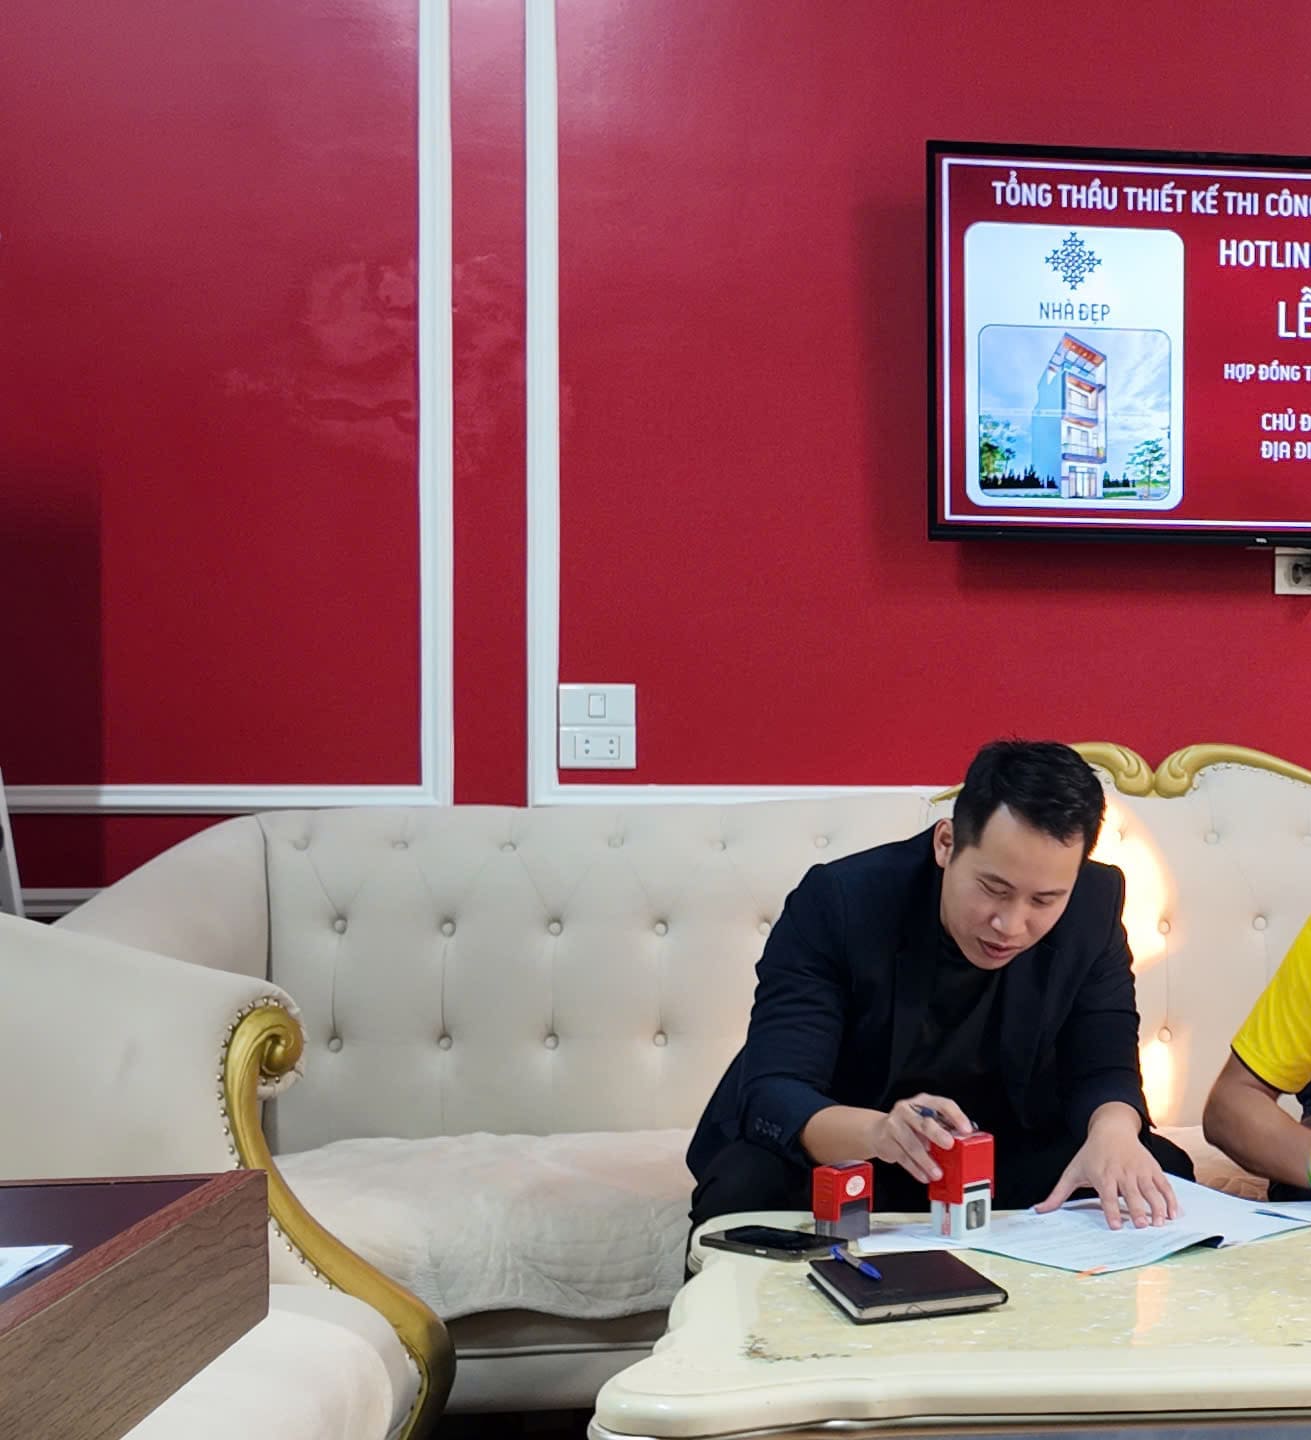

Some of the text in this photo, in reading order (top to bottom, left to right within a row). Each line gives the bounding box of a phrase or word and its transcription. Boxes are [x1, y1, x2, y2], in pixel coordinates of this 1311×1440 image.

[992, 171, 1052, 207] TỔNG
[1123, 182, 1186, 212] THIẾT
[1192, 184, 1219, 214] KẾ
[1223, 192, 1258, 215] THI
[1039, 299, 1111, 325] NHÀ ĐẸP
[1224, 363, 1255, 382] HỢP
[1262, 408, 1295, 431] CHỦ
[1261, 441, 1290, 461] ĐỊA
